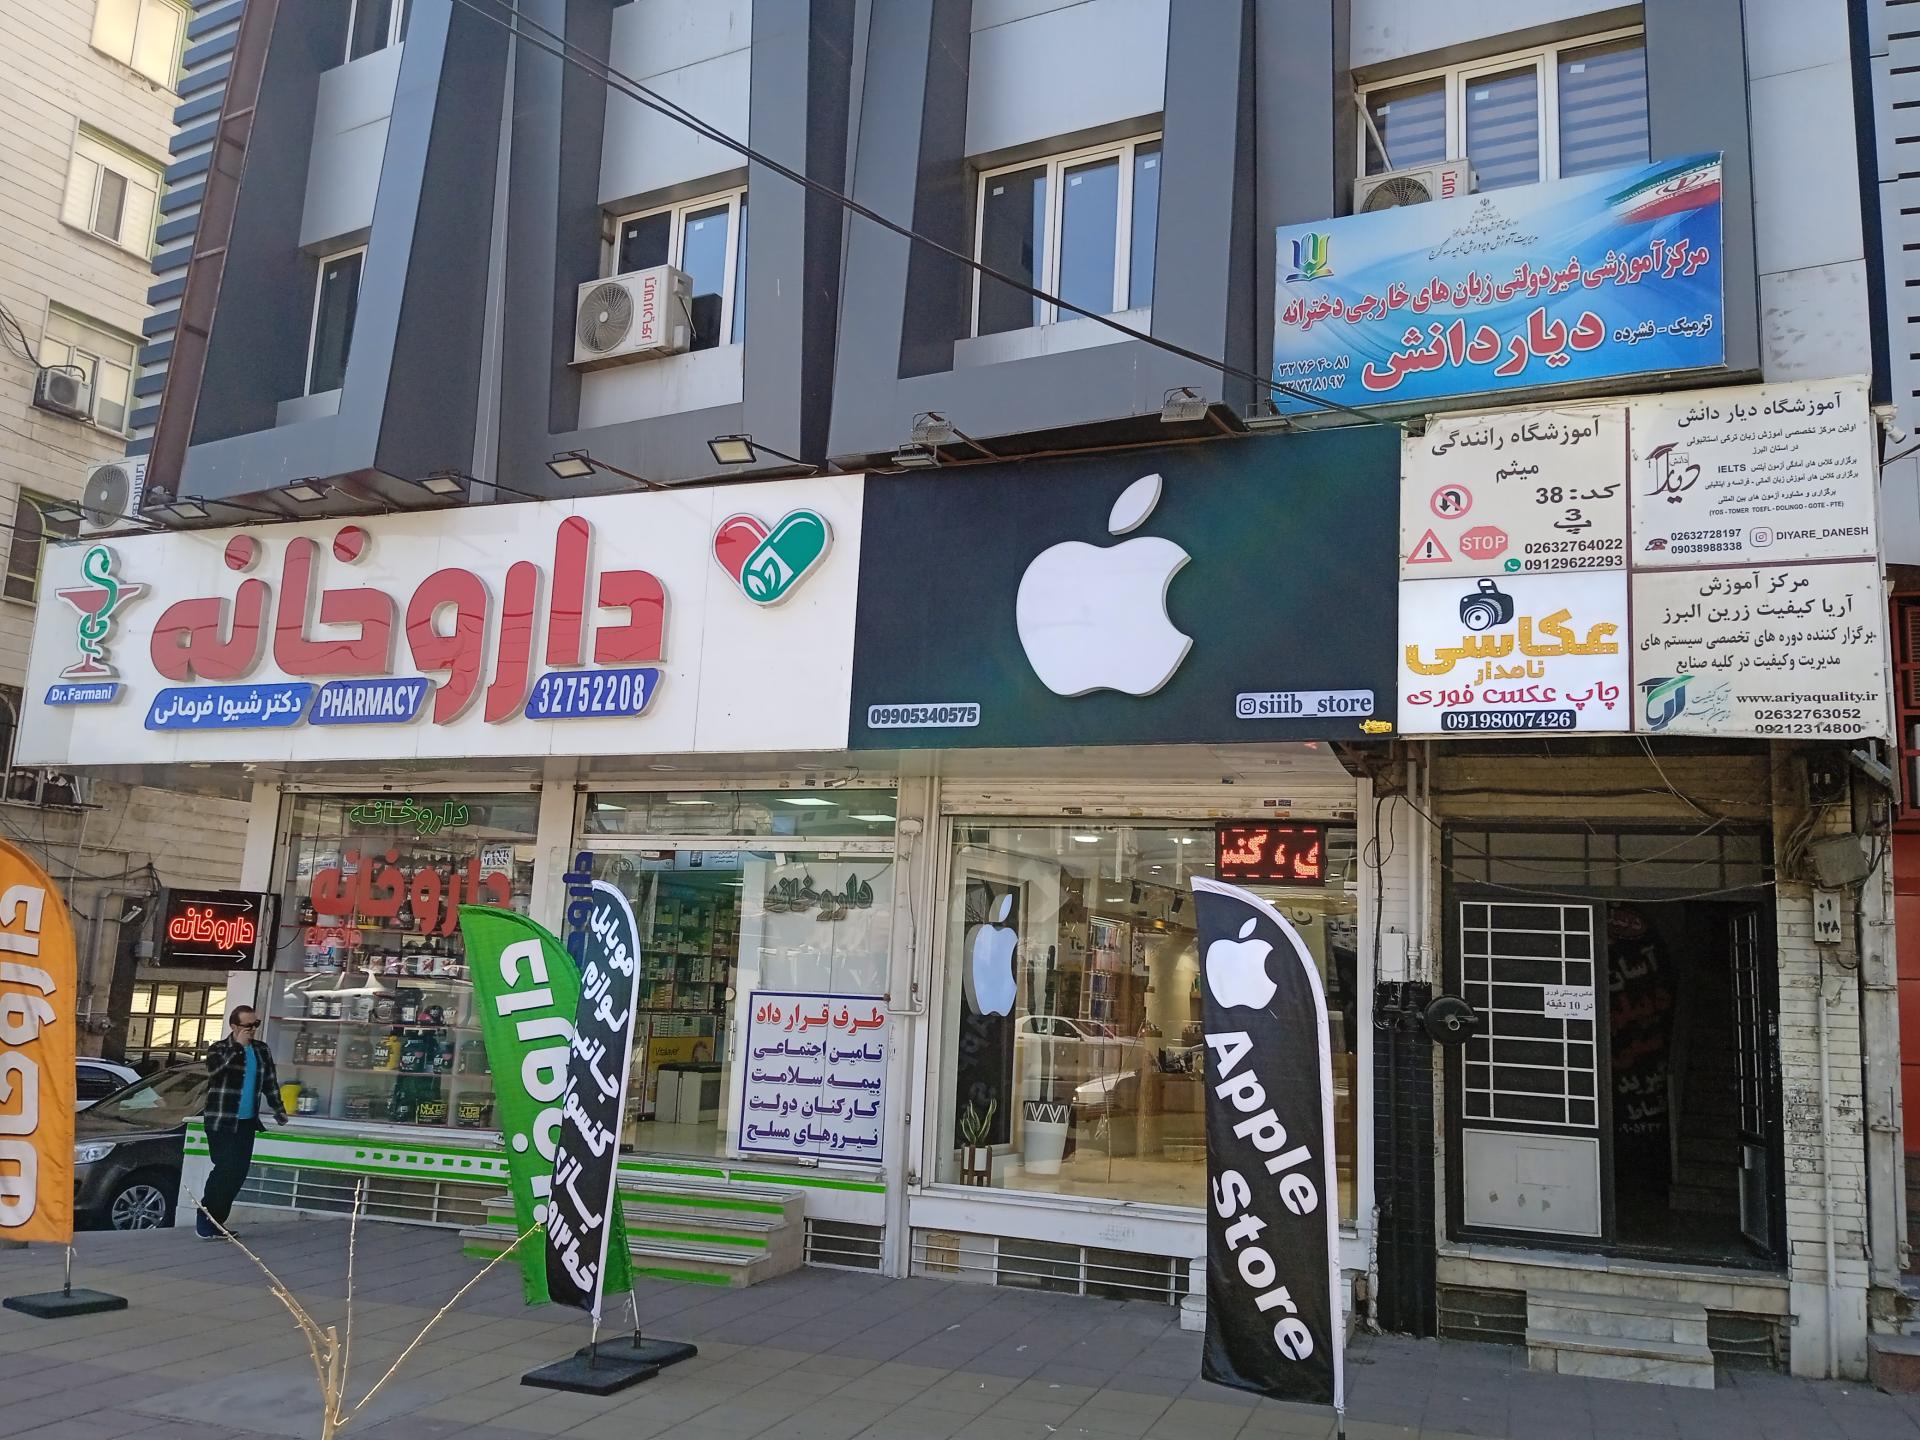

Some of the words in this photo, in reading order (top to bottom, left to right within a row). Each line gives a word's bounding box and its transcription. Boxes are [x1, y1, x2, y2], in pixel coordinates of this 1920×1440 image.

[1583, 239, 1666, 288] آموزشی
[1662, 238, 1709, 278] مرکز
[1412, 275, 1450, 314] های
[1452, 270, 1494, 307] زبان
[1282, 293, 1344, 332] دخترانه
[1345, 281, 1410, 324] خارجی
[1613, 320, 1656, 345] فشرده
[1668, 314, 1713, 336] ترمیک
[1495, 306, 1607, 378] دیار
[1361, 318, 1502, 392] دانش
[1726, 402, 1758, 424] دیار
[1763, 391, 1842, 418] آموزشگاه
[1677, 406, 1719, 428] دانش
[1838, 423, 1857, 433] اولین
[1510, 414, 1601, 446] آموزشگاه
[1720, 434, 1738, 444] ترکی
[1740, 432, 1755, 442] زبان
[1785, 428, 1815, 439] تخصصی
[1818, 426, 1836, 435] مرکز
[1431, 427, 1504, 456] رانندگی
[1752, 446, 1768, 455] البرز
[1770, 444, 1788, 453] استان
[1495, 460, 1539, 483] میثم
[1718, 464, 1746, 473] IELTS
[1818, 458, 1833, 467] کلاس
[1535, 487, 1564, 504] 38
[1461, 535, 1507, 551] STOP
[1671, 528, 1742, 542] 02632728197
[1776, 527, 1869, 540] DIYARE_DANESH
[1524, 538, 1623, 554] 02632764022
[1671, 541, 1743, 555] 09038988338
[1524, 554, 1623, 571] 09129622293
[1699, 571, 1760, 597] آموزش
[1767, 573, 1809, 594] مرکز
[1662, 604, 1701, 624] البرز
[1708, 603, 1751, 622] زرین
[1756, 599, 1815, 619] کیفیت
[1821, 593, 1853, 618] آریا
[150, 515, 667, 725] داروخانه
[1405, 608, 1619, 676] عکاسی
[1640, 635, 1661, 651] های
[1664, 635, 1703, 650] سیستم
[1706, 632, 1751, 650] تخصصی
[1753, 630, 1776, 647] های
[1778, 631, 1803, 646] دوره
[1806, 627, 1838, 641] کننده
[1841, 626, 1874, 646] برگزار
[1473, 659, 1545, 687] نامدار
[1675, 657, 1707, 674] صنایع
[1710, 655, 1734, 669] کلیه
[1738, 657, 1750, 672] در
[1798, 654, 1841, 671] مدیریت
[319, 685, 421, 718] PHARMACY
[537, 673, 645, 714] 32752208
[1406, 685, 1474, 708] فوری
[1482, 684, 1557, 706] عکس
[1565, 680, 1620, 711] چاپ
[1736, 691, 1879, 705] www.ariyaquality.ir
[153, 695, 214, 727] فرمانی
[217, 691, 258, 723] شیوا
[260, 689, 301, 722] دکتر
[871, 707, 977, 724] 09905340575
[1259, 694, 1372, 716] siiib_store
[1754, 709, 1861, 720] 02632763052
[1446, 712, 1572, 729] 09198007426
[1755, 723, 1862, 735] 09212314800
[350, 797, 470, 835] داروخانه
[311, 850, 511, 938] داروخانه
[763, 873, 874, 922] داروخانه
[169, 908, 255, 950] داروخانه
[590, 904, 634, 977] موبایل
[582, 961, 629, 1033] لوازم
[1546, 999, 1566, 1009] دقیقه
[1570, 1001, 1580, 1009] 10
[756, 1002, 782, 1023] داد
[784, 1003, 829, 1032] قرار
[833, 1004, 886, 1035] طرف
[753, 1038, 827, 1062] اجتماعی
[829, 1043, 883, 1063] تامین
[752, 1066, 823, 1085] سلامت
[827, 1073, 881, 1094] بیمه
[750, 1093, 798, 1115] دولت
[801, 1096, 880, 1120] کارکنان
[747, 1120, 790, 1141] مسلح
[1205, 1030, 1319, 1216] Apple
[794, 1123, 878, 1149] نیروهای
[561, 1237, 598, 1293] خط
[1212, 1168, 1315, 1362] Store
